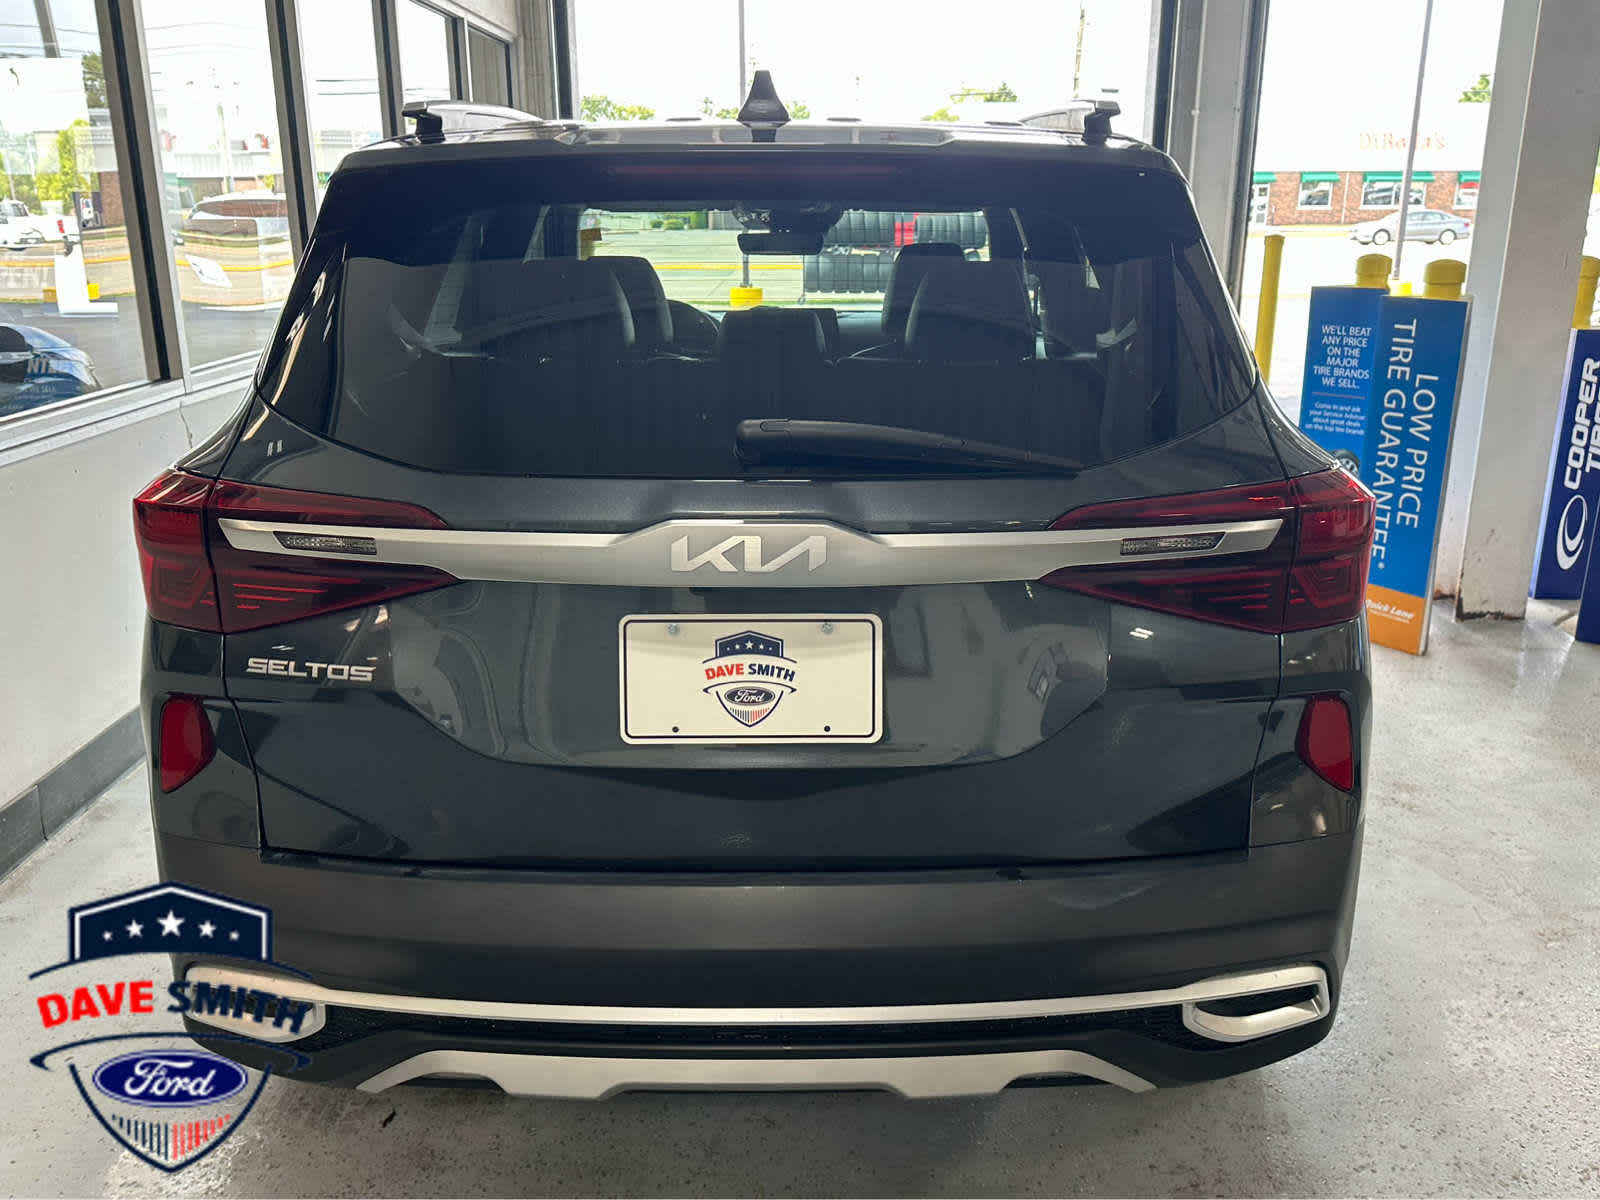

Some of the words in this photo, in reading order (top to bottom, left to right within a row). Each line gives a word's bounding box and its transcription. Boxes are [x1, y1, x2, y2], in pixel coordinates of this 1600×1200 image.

[1321, 324, 1347, 336] WE'LL
[1349, 326, 1372, 337] BEAT
[1321, 335, 1341, 345] ANY
[1343, 336, 1368, 348] PRICE
[1386, 318, 1417, 381] TIRE
[1327, 346, 1341, 356] ON
[1343, 346, 1361, 358] THE
[1326, 356, 1359, 368] MAJOR
[1313, 365, 1331, 377] TIRE
[1333, 367, 1370, 380] BRANDS
[1321, 376, 1336, 387] WE
[1337, 377, 1360, 390] SELL.
[1408, 373, 1440, 443] LOW
[1563, 357, 1600, 490] COOPER
[1395, 447, 1429, 529] PRICE
[671, 535, 827, 573] KIA
[245, 657, 377, 682] SELTOS
[704, 663, 744, 681] DAVE
[748, 663, 796, 682] SMITH
[734, 689, 765, 703] Ford
